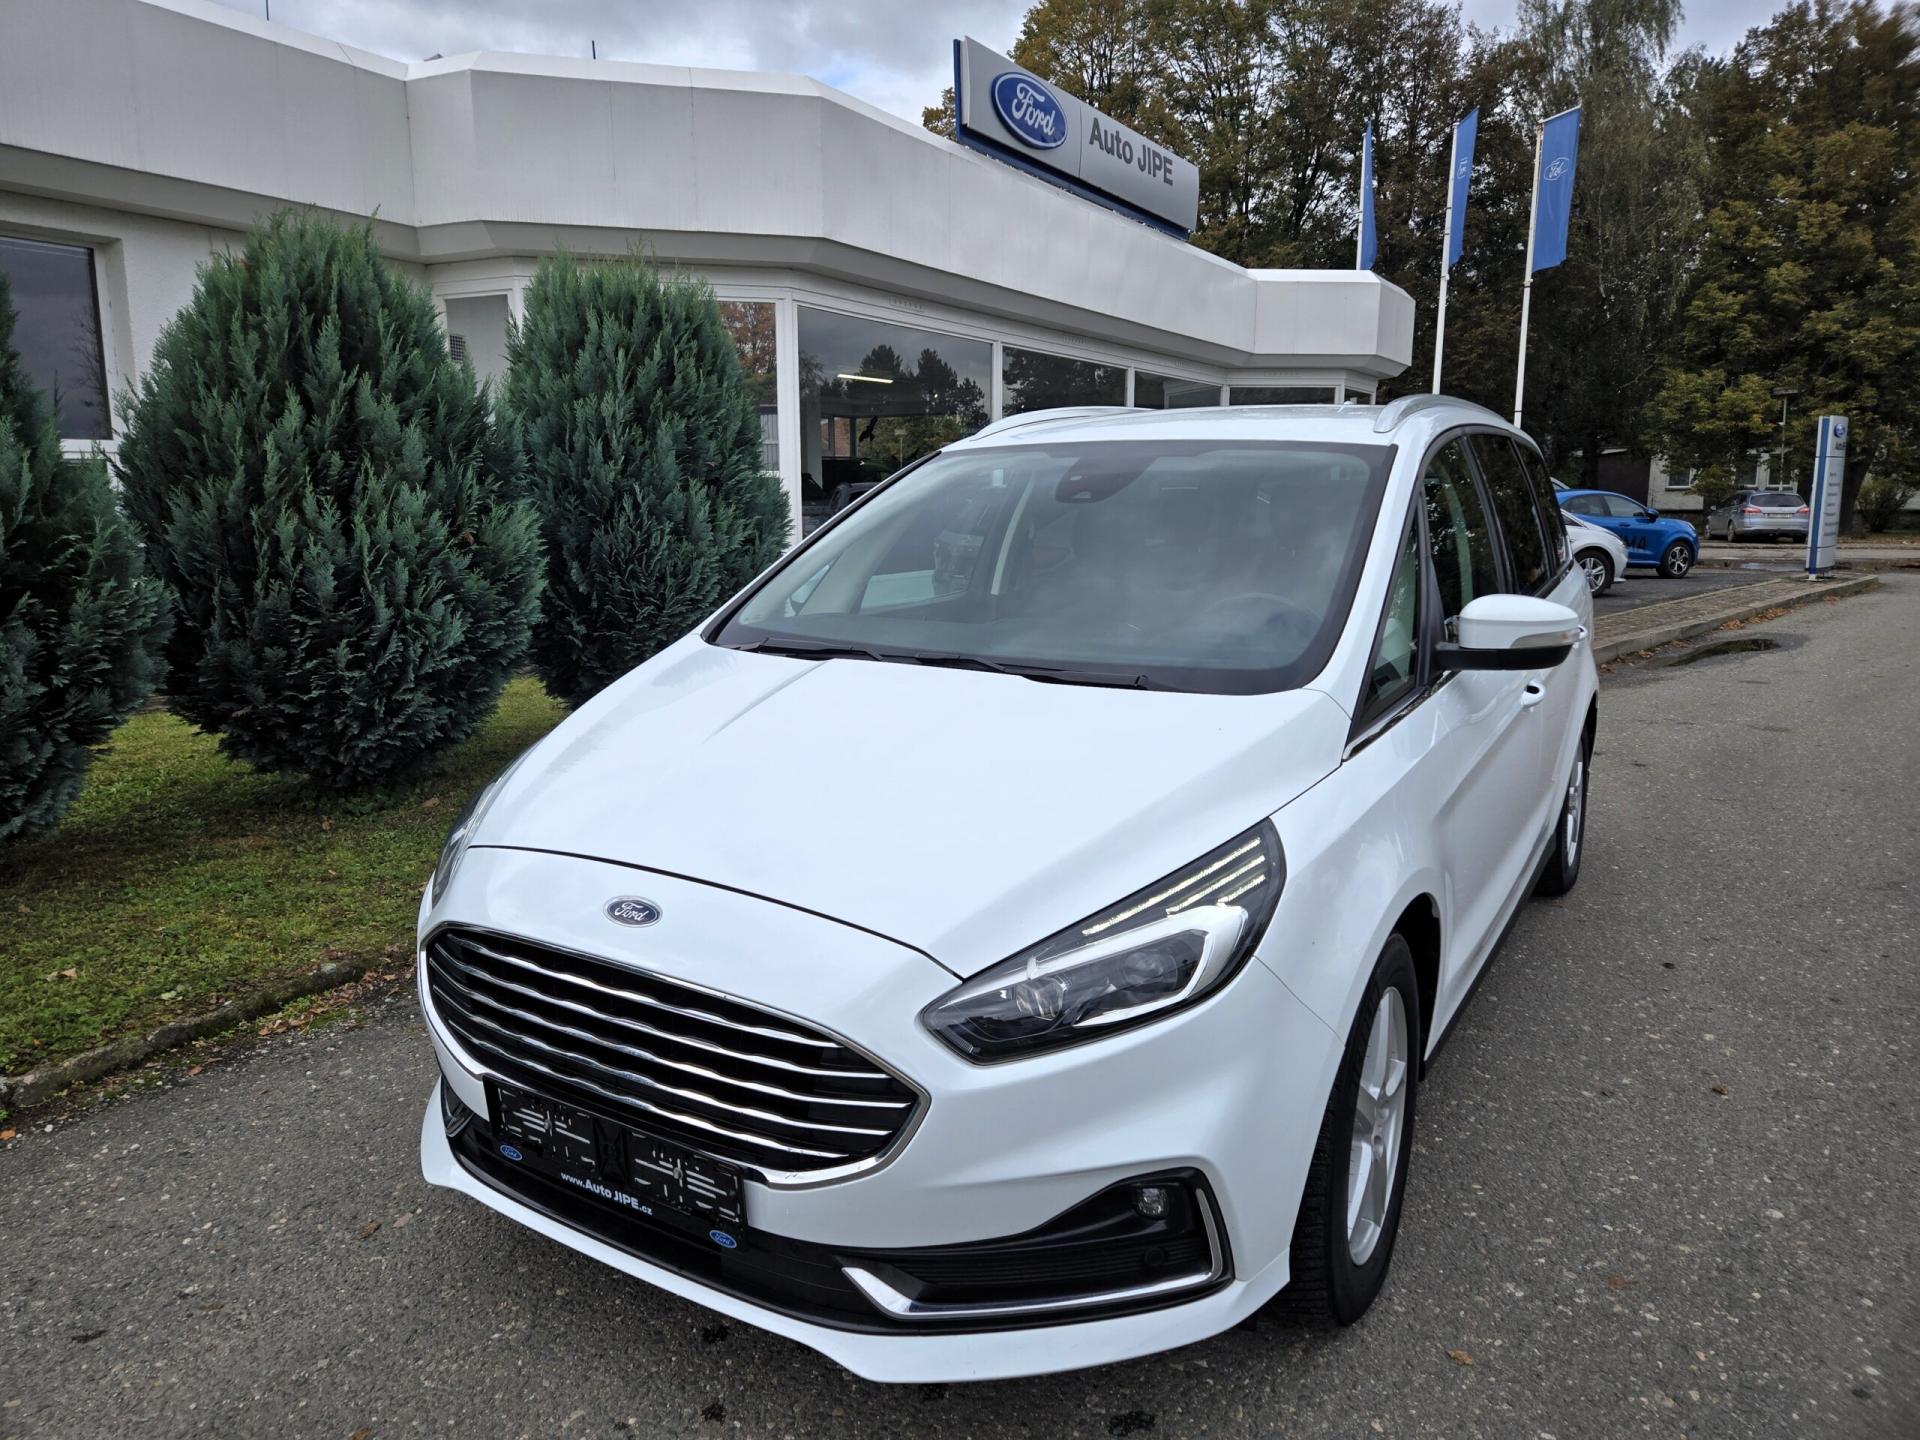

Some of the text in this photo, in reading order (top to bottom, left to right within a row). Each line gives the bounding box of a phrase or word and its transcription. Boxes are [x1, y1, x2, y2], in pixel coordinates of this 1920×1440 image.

[1011, 82, 1056, 137] Ford
[1089, 117, 1174, 186] Auto JIPE
[614, 901, 650, 922] Ford
[560, 1172, 653, 1216] www.Auto JIPE.cz
